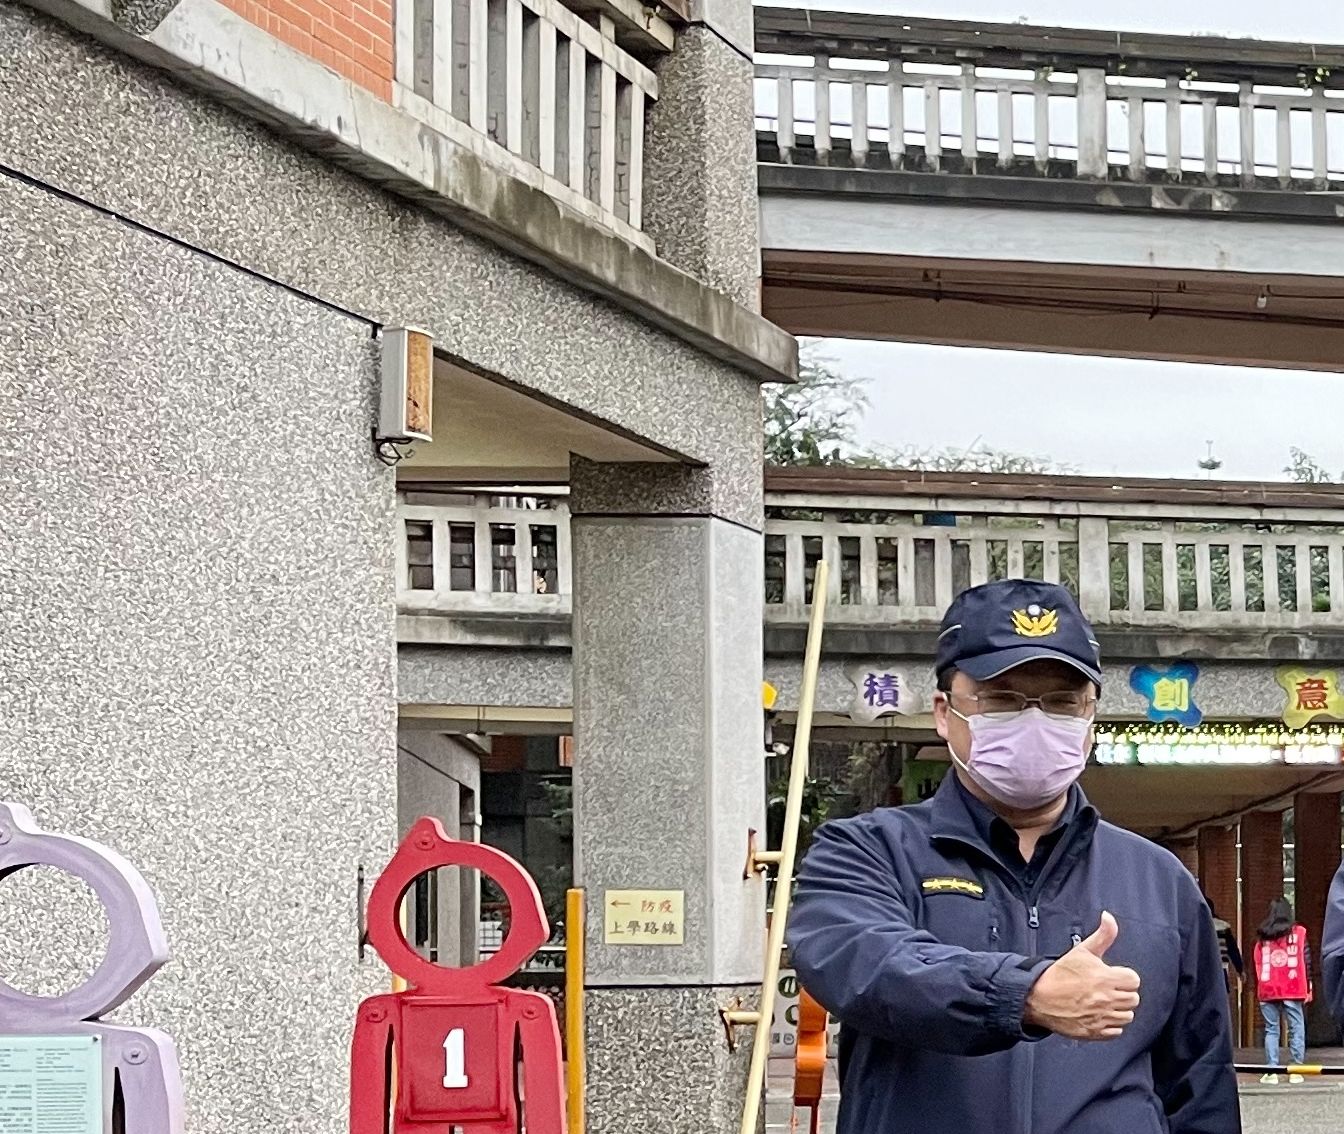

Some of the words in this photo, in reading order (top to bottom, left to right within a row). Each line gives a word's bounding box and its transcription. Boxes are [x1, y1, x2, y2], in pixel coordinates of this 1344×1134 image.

[864, 673, 899, 707] 積
[1153, 678, 1188, 711] 創
[1296, 678, 1328, 711] 意
[641, 900, 673, 914] 防疫
[609, 920, 678, 936] 上學路線
[442, 1028, 469, 1089] 1
